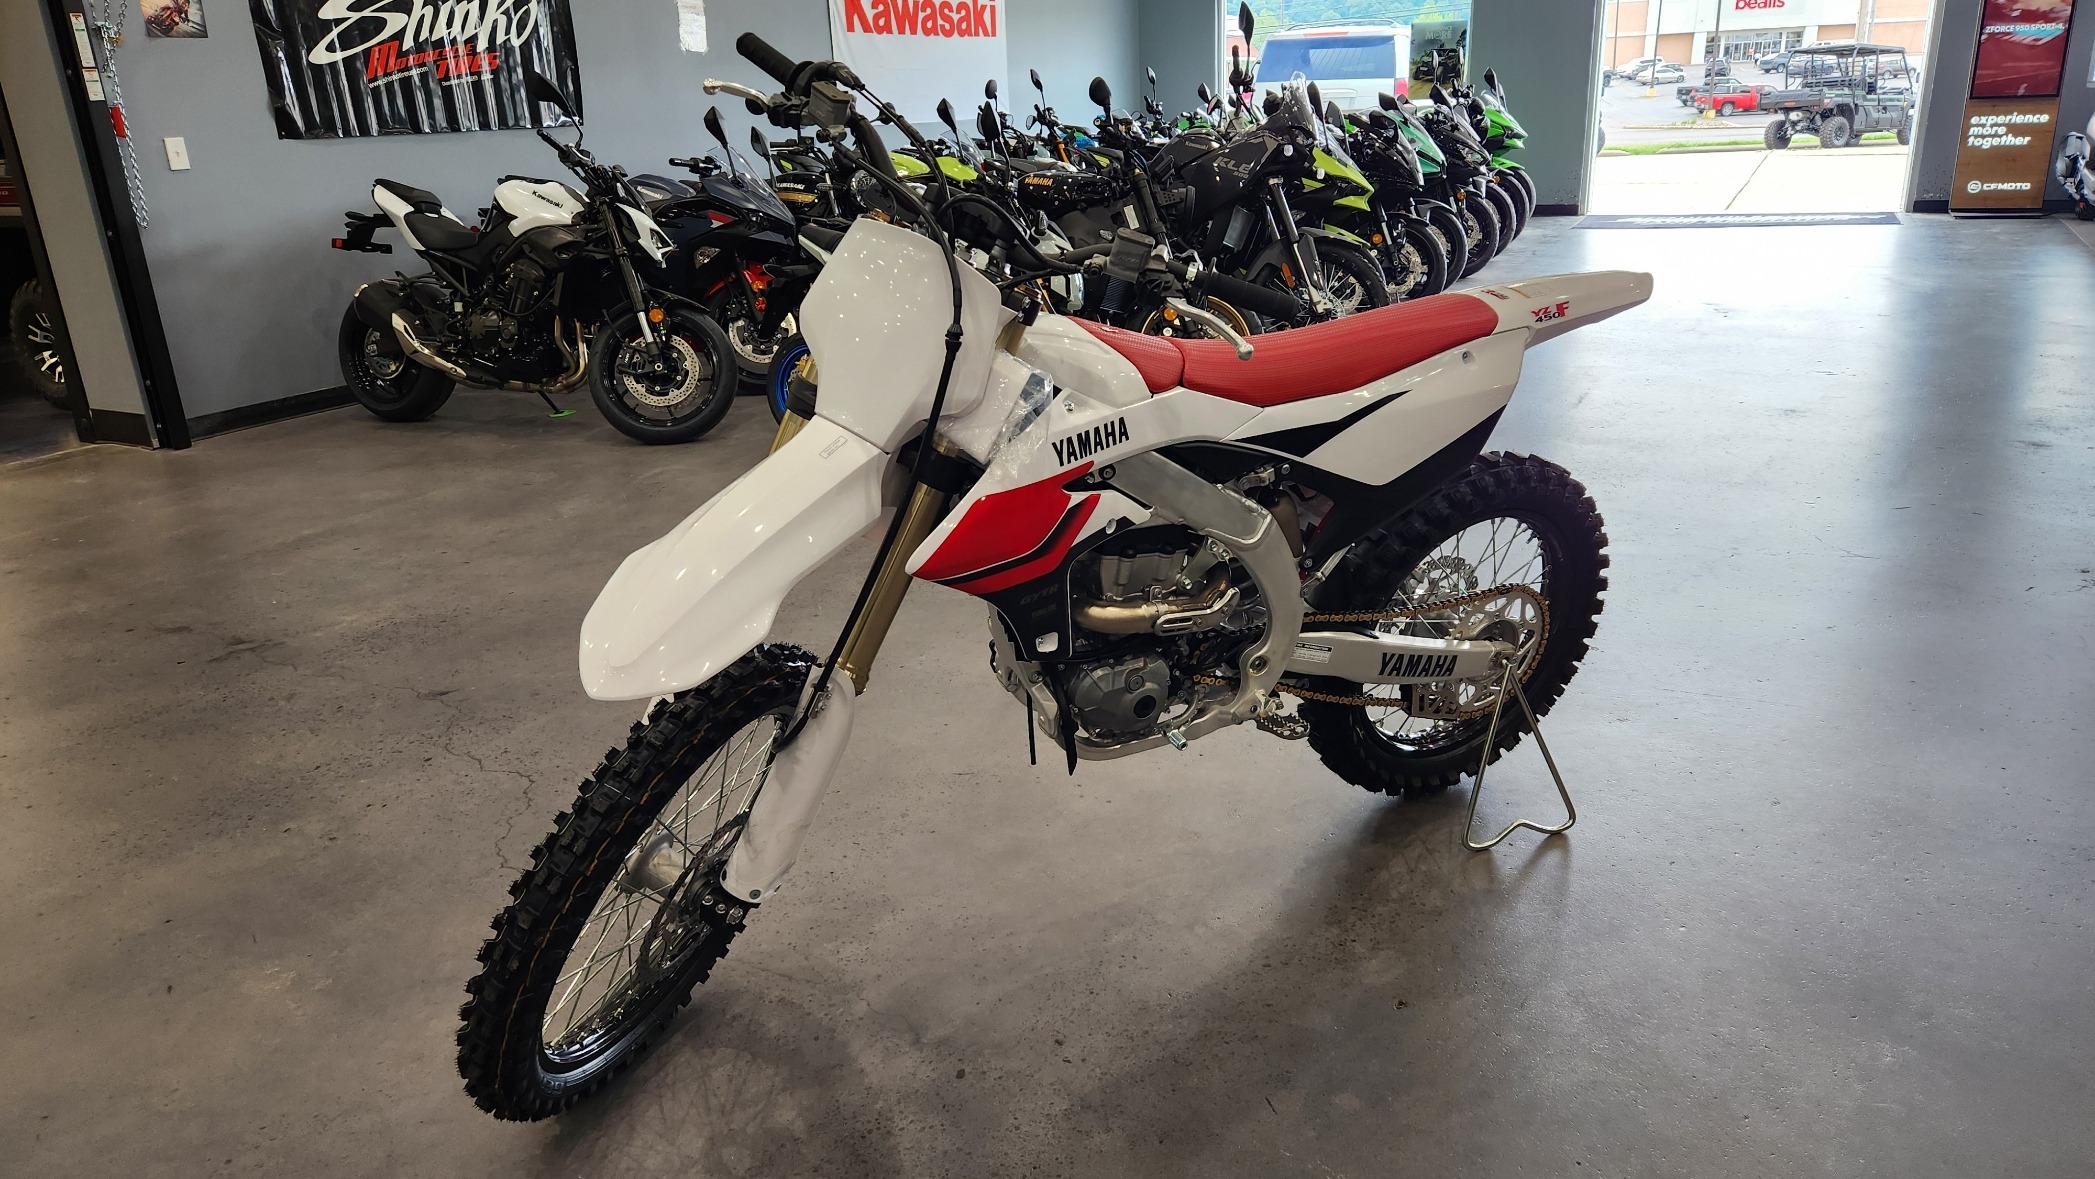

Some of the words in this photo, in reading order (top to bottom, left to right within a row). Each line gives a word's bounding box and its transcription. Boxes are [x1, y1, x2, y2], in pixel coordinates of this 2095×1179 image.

[1735, 0, 1785, 10] bealls
[844, 0, 997, 38] Kawasaki
[308, 0, 537, 64] Shinko
[1985, 24, 2015, 33] ZFORCE
[2015, 24, 2030, 32] 950
[1970, 112, 2049, 127] experience
[1968, 125, 2007, 135] more
[1967, 134, 2031, 148] together
[1214, 156, 1251, 173] KLE
[1024, 176, 1054, 187] YAMAHA
[1983, 182, 2031, 191] CFMOTO
[532, 190, 564, 209] Kawasaki
[636, 185, 664, 200] Kawasaki
[1535, 311, 1561, 323] 450
[1052, 416, 1130, 467] YAMAHA
[1378, 652, 1458, 677] YAMAHA
